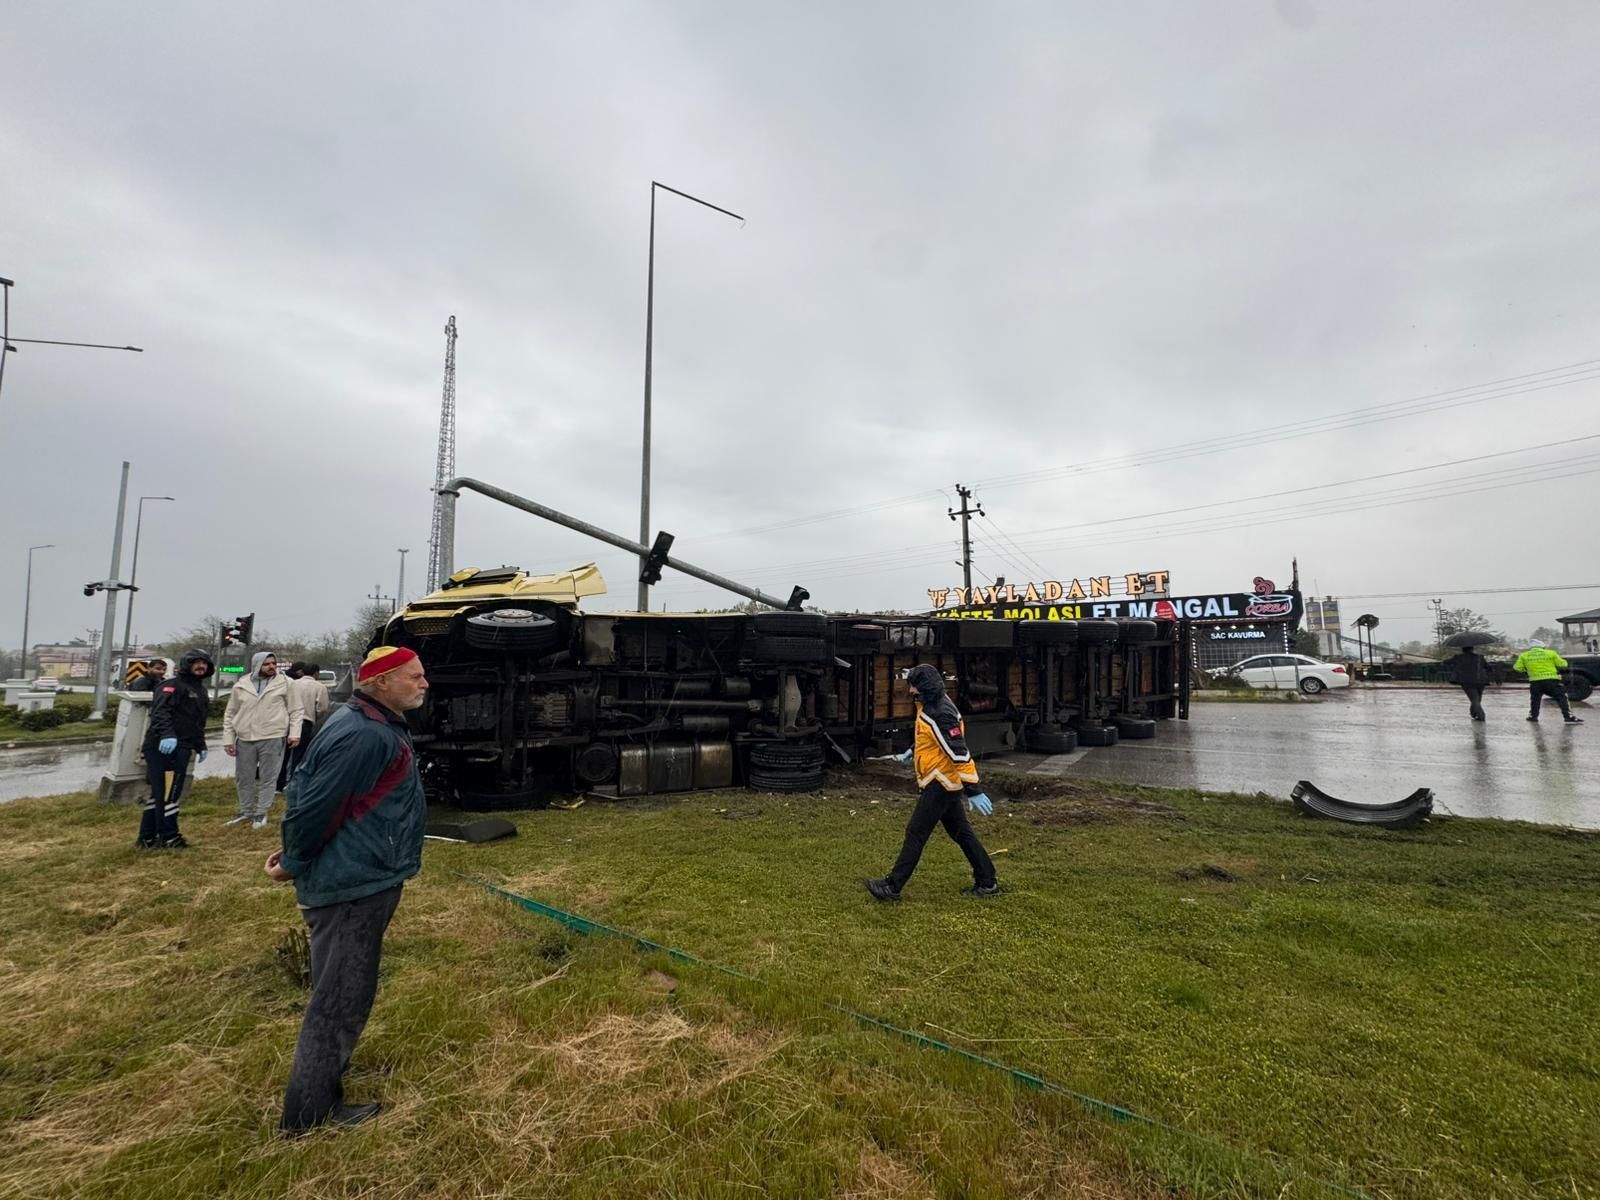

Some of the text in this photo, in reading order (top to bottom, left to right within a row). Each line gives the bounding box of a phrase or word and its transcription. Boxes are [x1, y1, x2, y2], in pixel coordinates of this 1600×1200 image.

[953, 571, 1169, 606] YAYLADAN ET
[1092, 603, 1121, 618] ET
[1228, 631, 1266, 639] KAVURMA
